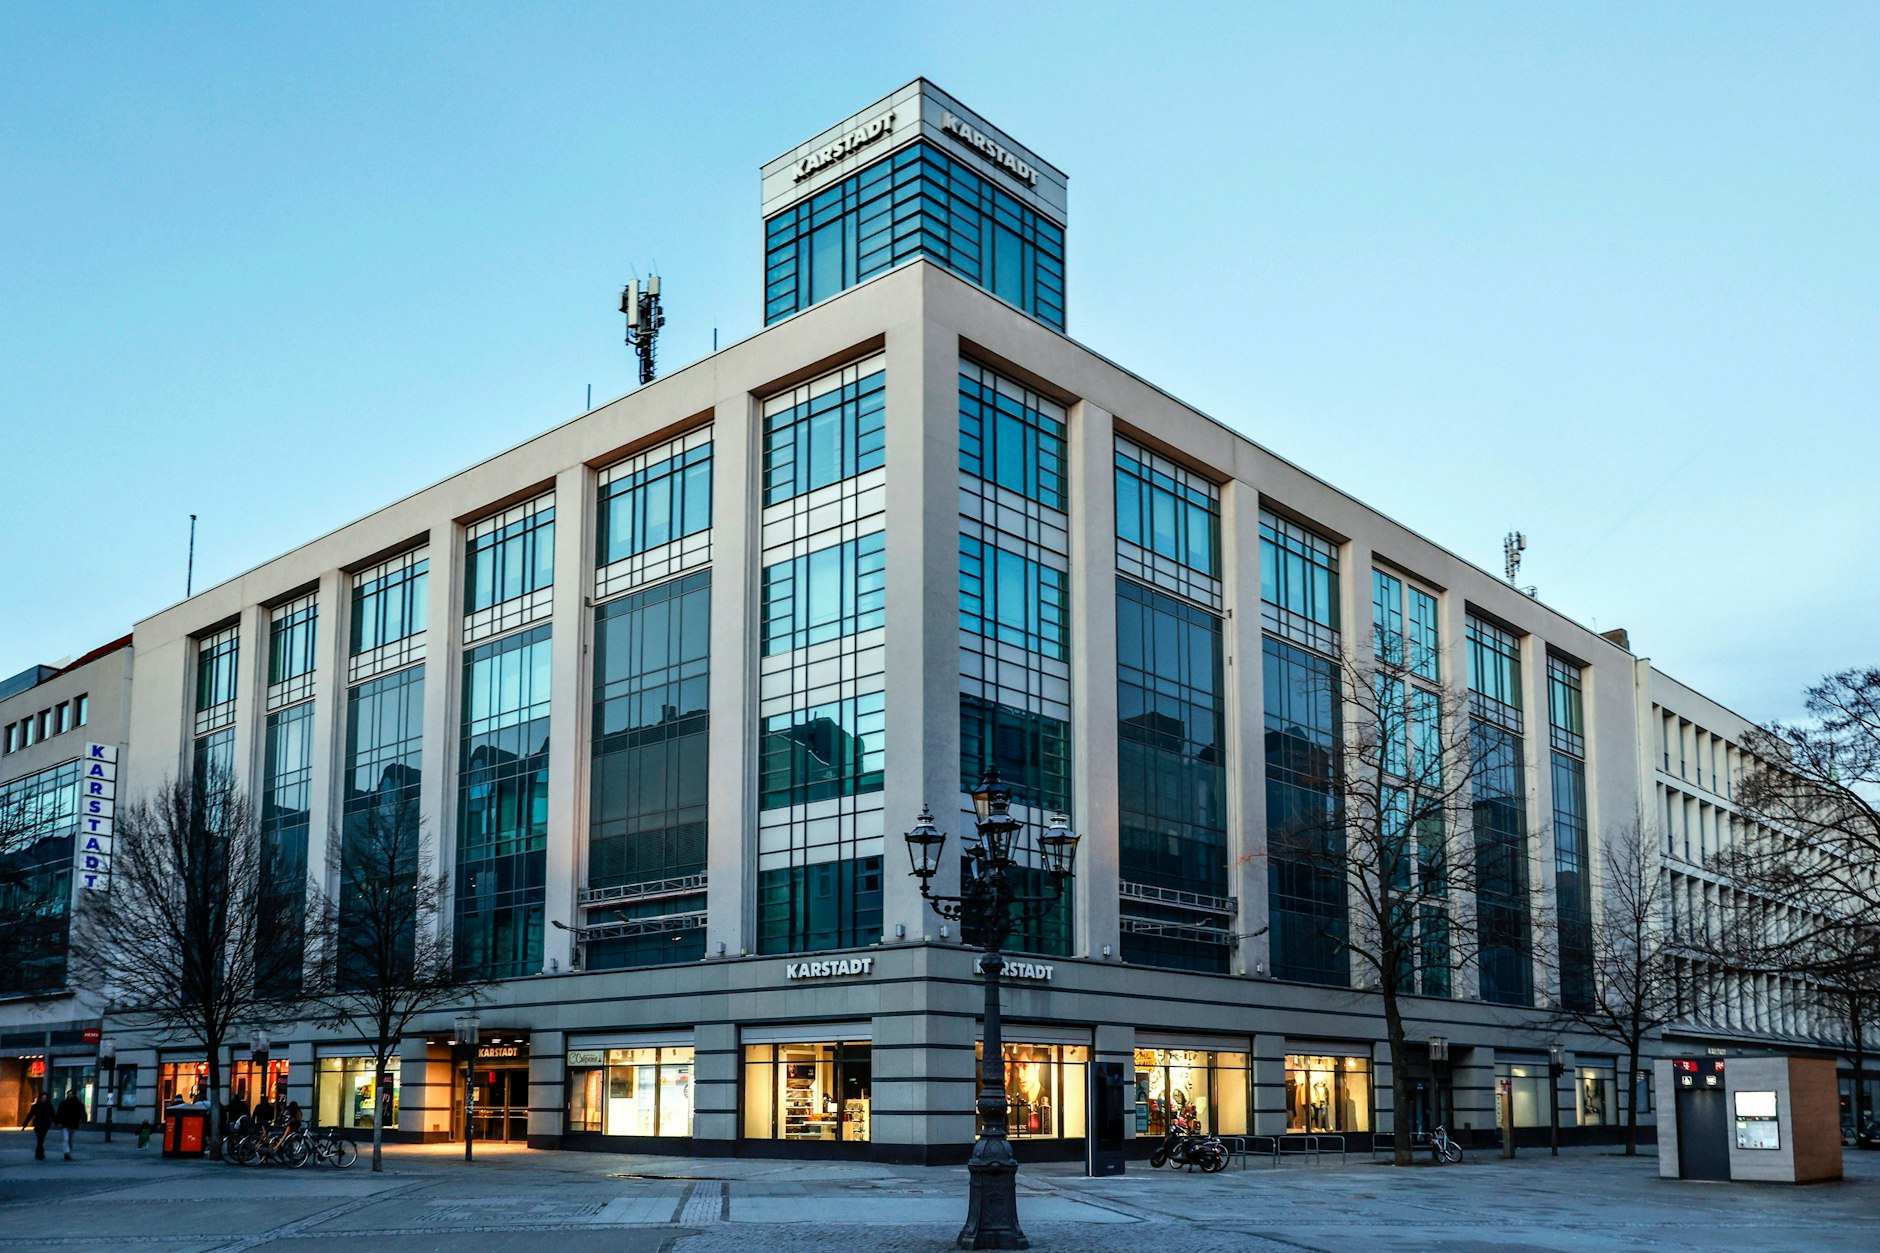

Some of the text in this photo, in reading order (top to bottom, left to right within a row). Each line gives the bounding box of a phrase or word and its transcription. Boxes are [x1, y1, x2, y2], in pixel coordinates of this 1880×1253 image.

[791, 111, 896, 183] KARSTADT
[941, 111, 1039, 187] KARSTADT
[84, 744, 105, 887] KARSTADT
[786, 957, 874, 980] KARSTADT
[973, 958, 1054, 980] KRSTADT
[478, 1047, 518, 1058] KARSTADT
